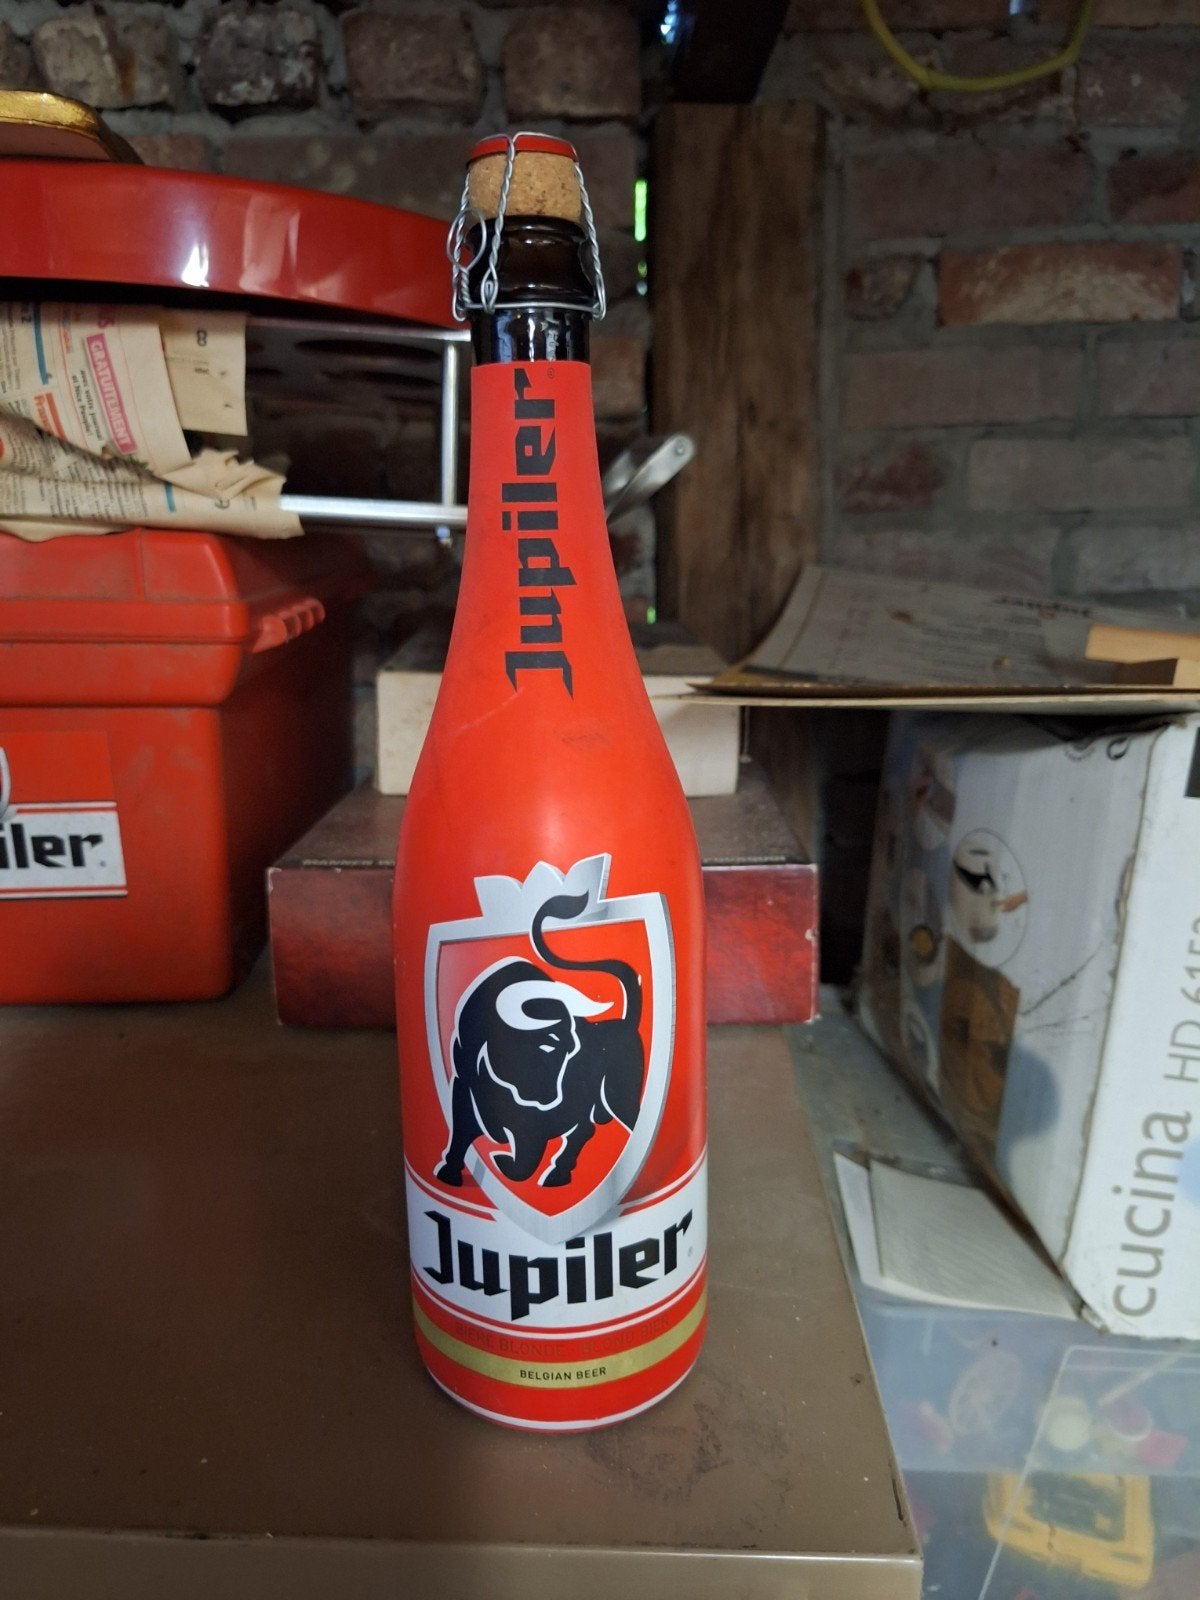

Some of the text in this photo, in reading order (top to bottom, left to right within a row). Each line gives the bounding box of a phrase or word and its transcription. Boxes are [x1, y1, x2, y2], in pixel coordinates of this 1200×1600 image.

[92, 341, 131, 446] GRATUITEMENT
[502, 368, 576, 700] Jupiler
[1111, 1109, 1193, 1317] cucina
[1163, 1018, 1200, 1082] HD
[423, 1209, 692, 1321] Jupiler
[499, 1339, 564, 1356] BLONDE
[520, 1367, 606, 1381] BELGIAN BEER
